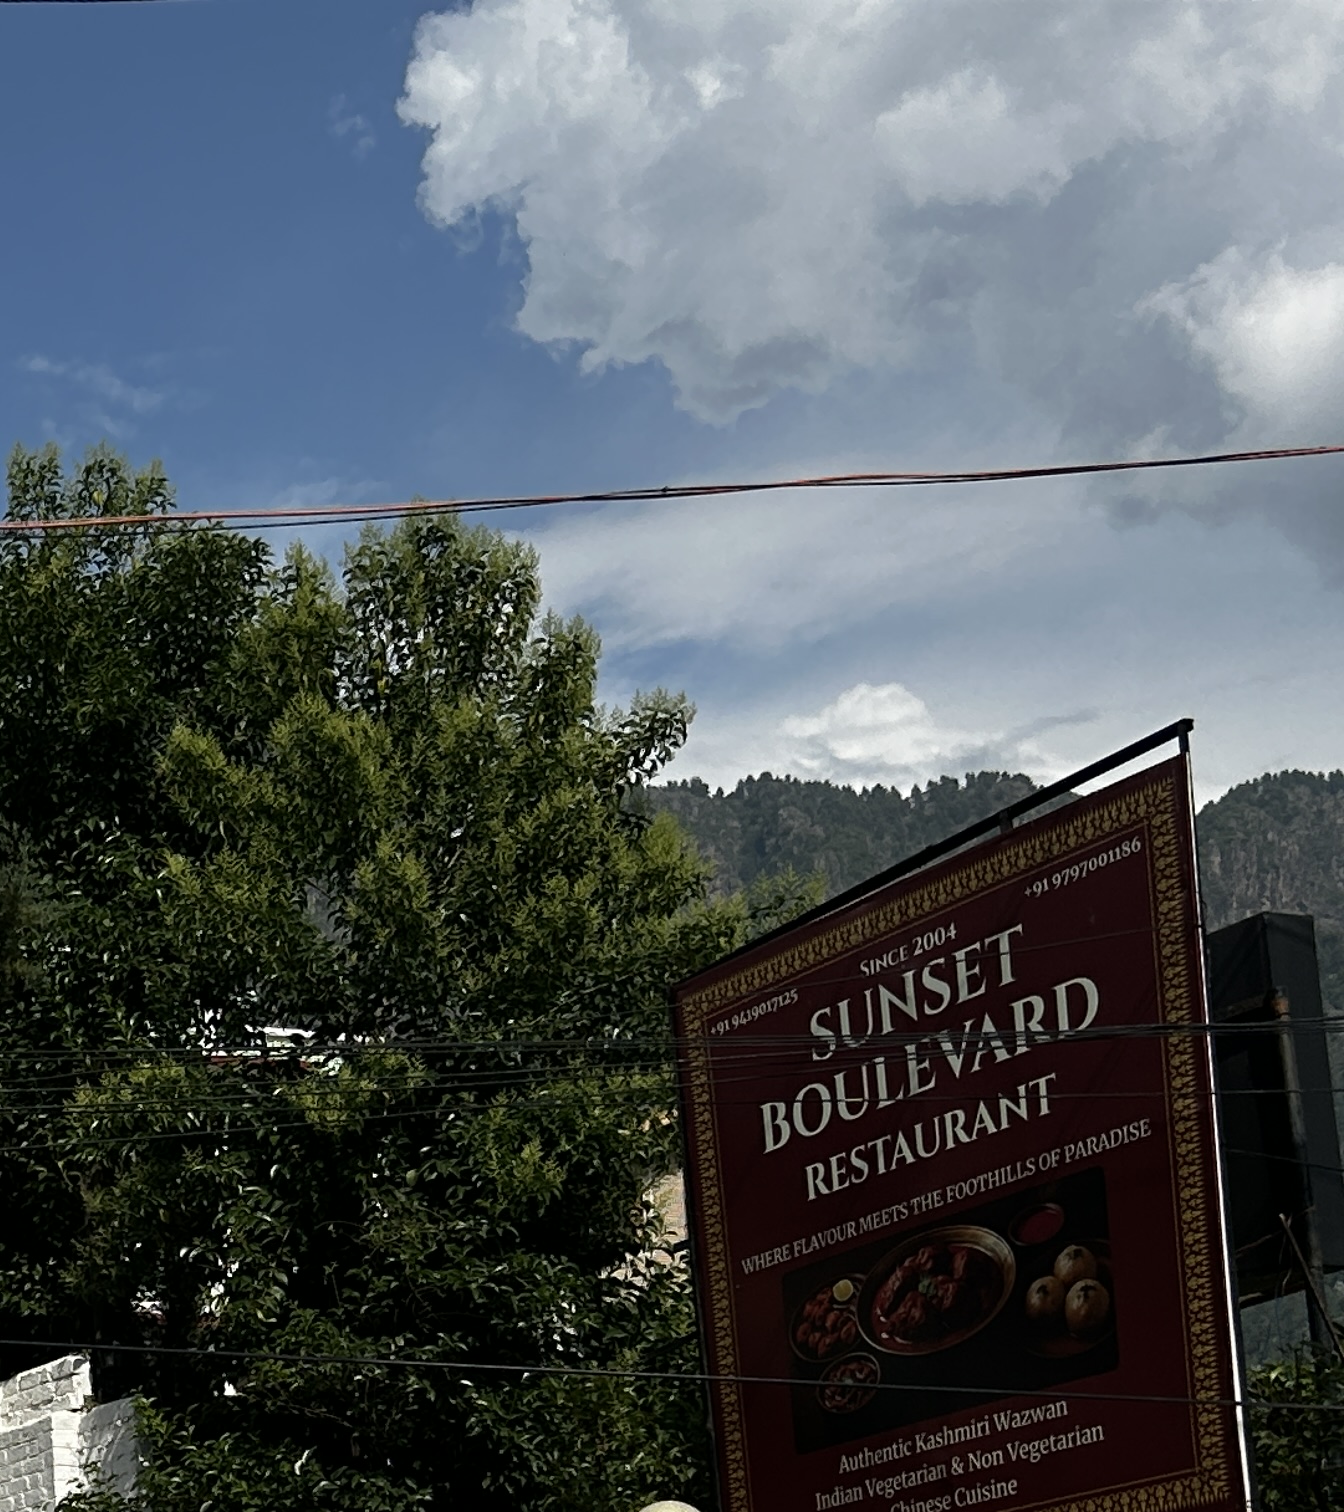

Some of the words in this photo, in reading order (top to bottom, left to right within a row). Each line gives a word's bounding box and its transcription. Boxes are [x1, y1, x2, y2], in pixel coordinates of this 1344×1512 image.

[1023, 877, 1049, 898] +91
[1051, 835, 1142, 891] 9797001186
[859, 944, 909, 977] SINCE
[912, 921, 957, 957] 2004
[809, 923, 1024, 1062] SUNSET
[759, 976, 1100, 1155] BOULEVARD
[804, 1072, 1057, 1202] RESTAURANT
[741, 1245, 792, 1275] WHERE
[793, 1219, 858, 1259] FLAVOUR
[859, 1202, 909, 1236] MEETS
[911, 1189, 943, 1216] THE
[946, 1156, 1037, 1204] FOOTHILLS
[1039, 1147, 1061, 1172] OF
[1064, 1118, 1152, 1165] PARADISE
[815, 1482, 863, 1511] Indian
[865, 1460, 947, 1499] Vegetarian
[950, 1455, 964, 1476] &
[968, 1446, 1005, 1472] Non
[1006, 1425, 1105, 1463] Vegetarian
[838, 1440, 912, 1475] Authentic
[915, 1414, 991, 1454] Kashmiri
[993, 1399, 1069, 1432] Wazwan
[954, 1478, 1018, 1508] Cuisine
